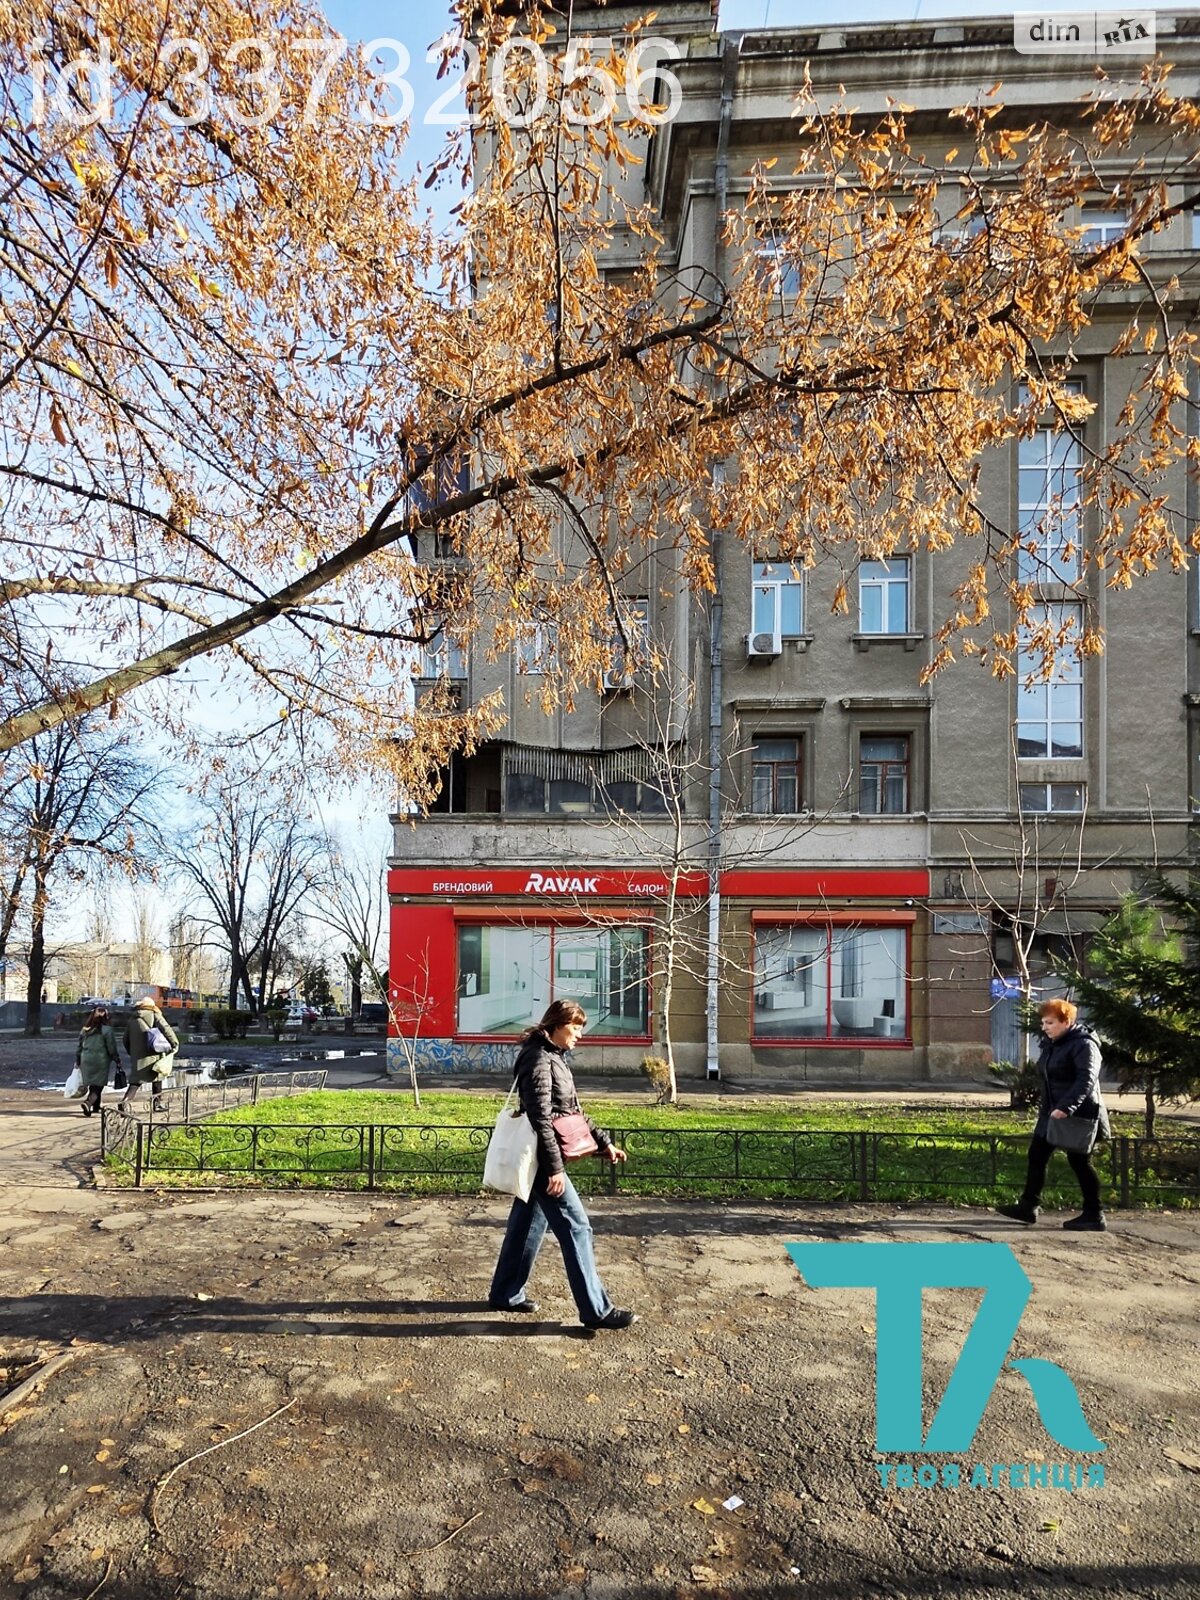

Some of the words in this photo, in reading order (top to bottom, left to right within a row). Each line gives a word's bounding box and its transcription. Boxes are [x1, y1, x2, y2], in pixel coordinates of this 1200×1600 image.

[432, 881, 493, 893] БРЕНДОВИЙ
[524, 873, 600, 893] RAVAK
[628, 883, 664, 893] САЛОН
